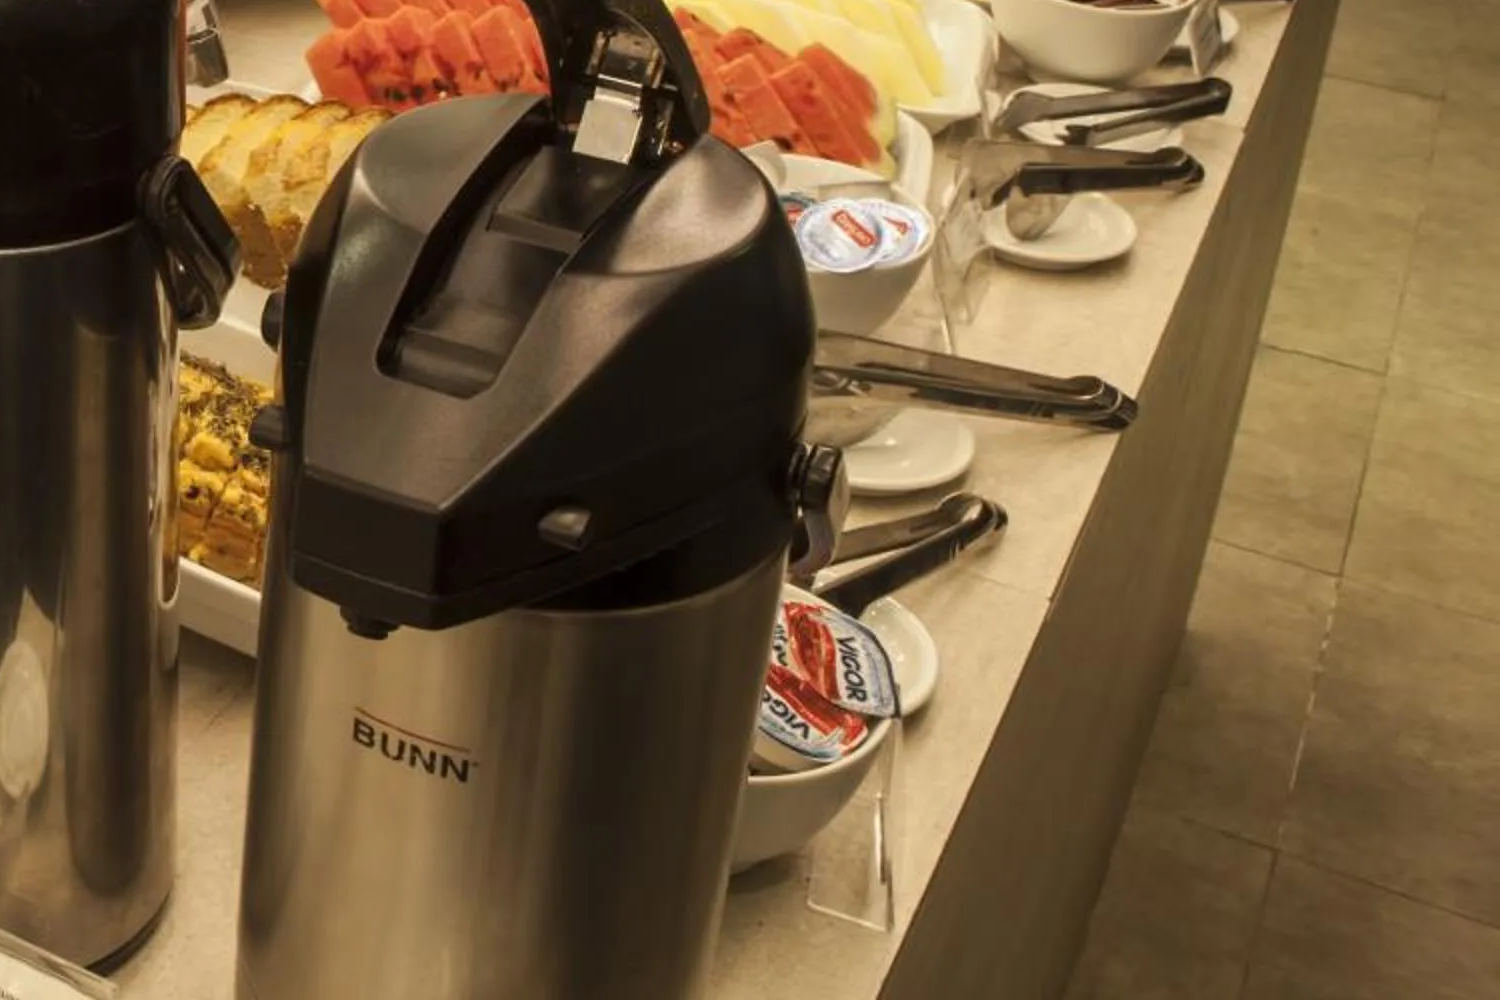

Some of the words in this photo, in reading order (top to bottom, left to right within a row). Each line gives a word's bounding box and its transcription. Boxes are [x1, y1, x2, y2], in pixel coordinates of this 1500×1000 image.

[836, 637, 868, 703] VIGOR
[761, 692, 811, 740] VIG
[353, 716, 470, 784] BUNN
